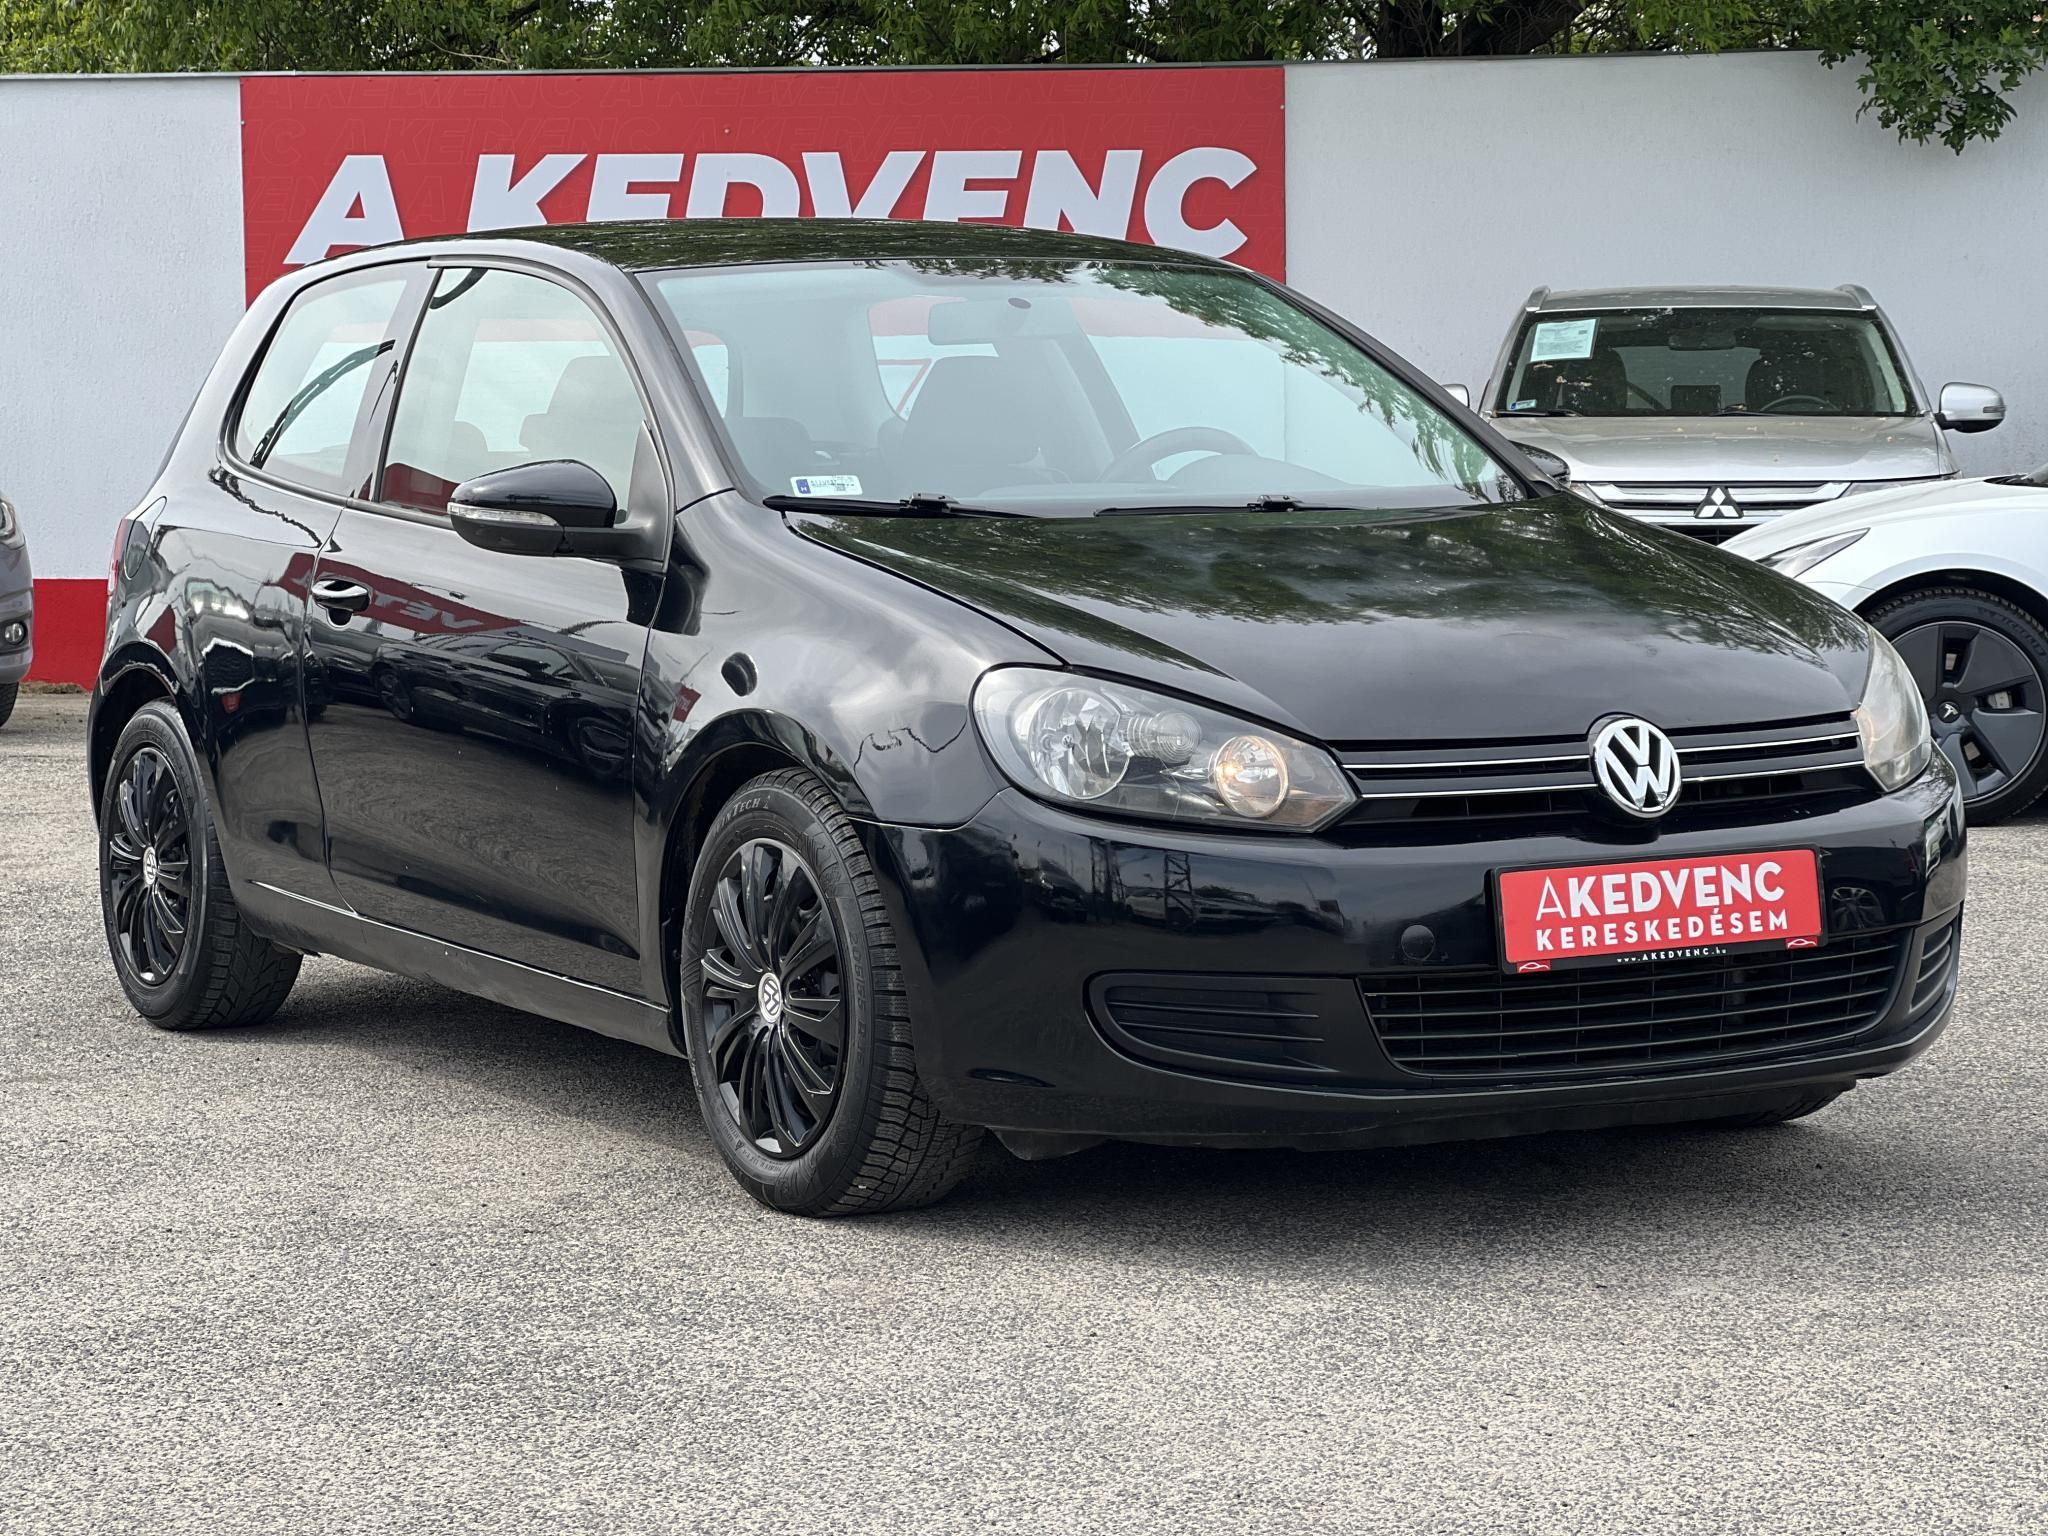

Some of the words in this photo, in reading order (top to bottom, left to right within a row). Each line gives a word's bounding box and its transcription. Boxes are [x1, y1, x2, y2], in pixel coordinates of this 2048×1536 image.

[282, 154, 404, 264] A
[467, 147, 1257, 257] KEDVENC
[1535, 908, 1789, 952] KERESKEDÉSEM
